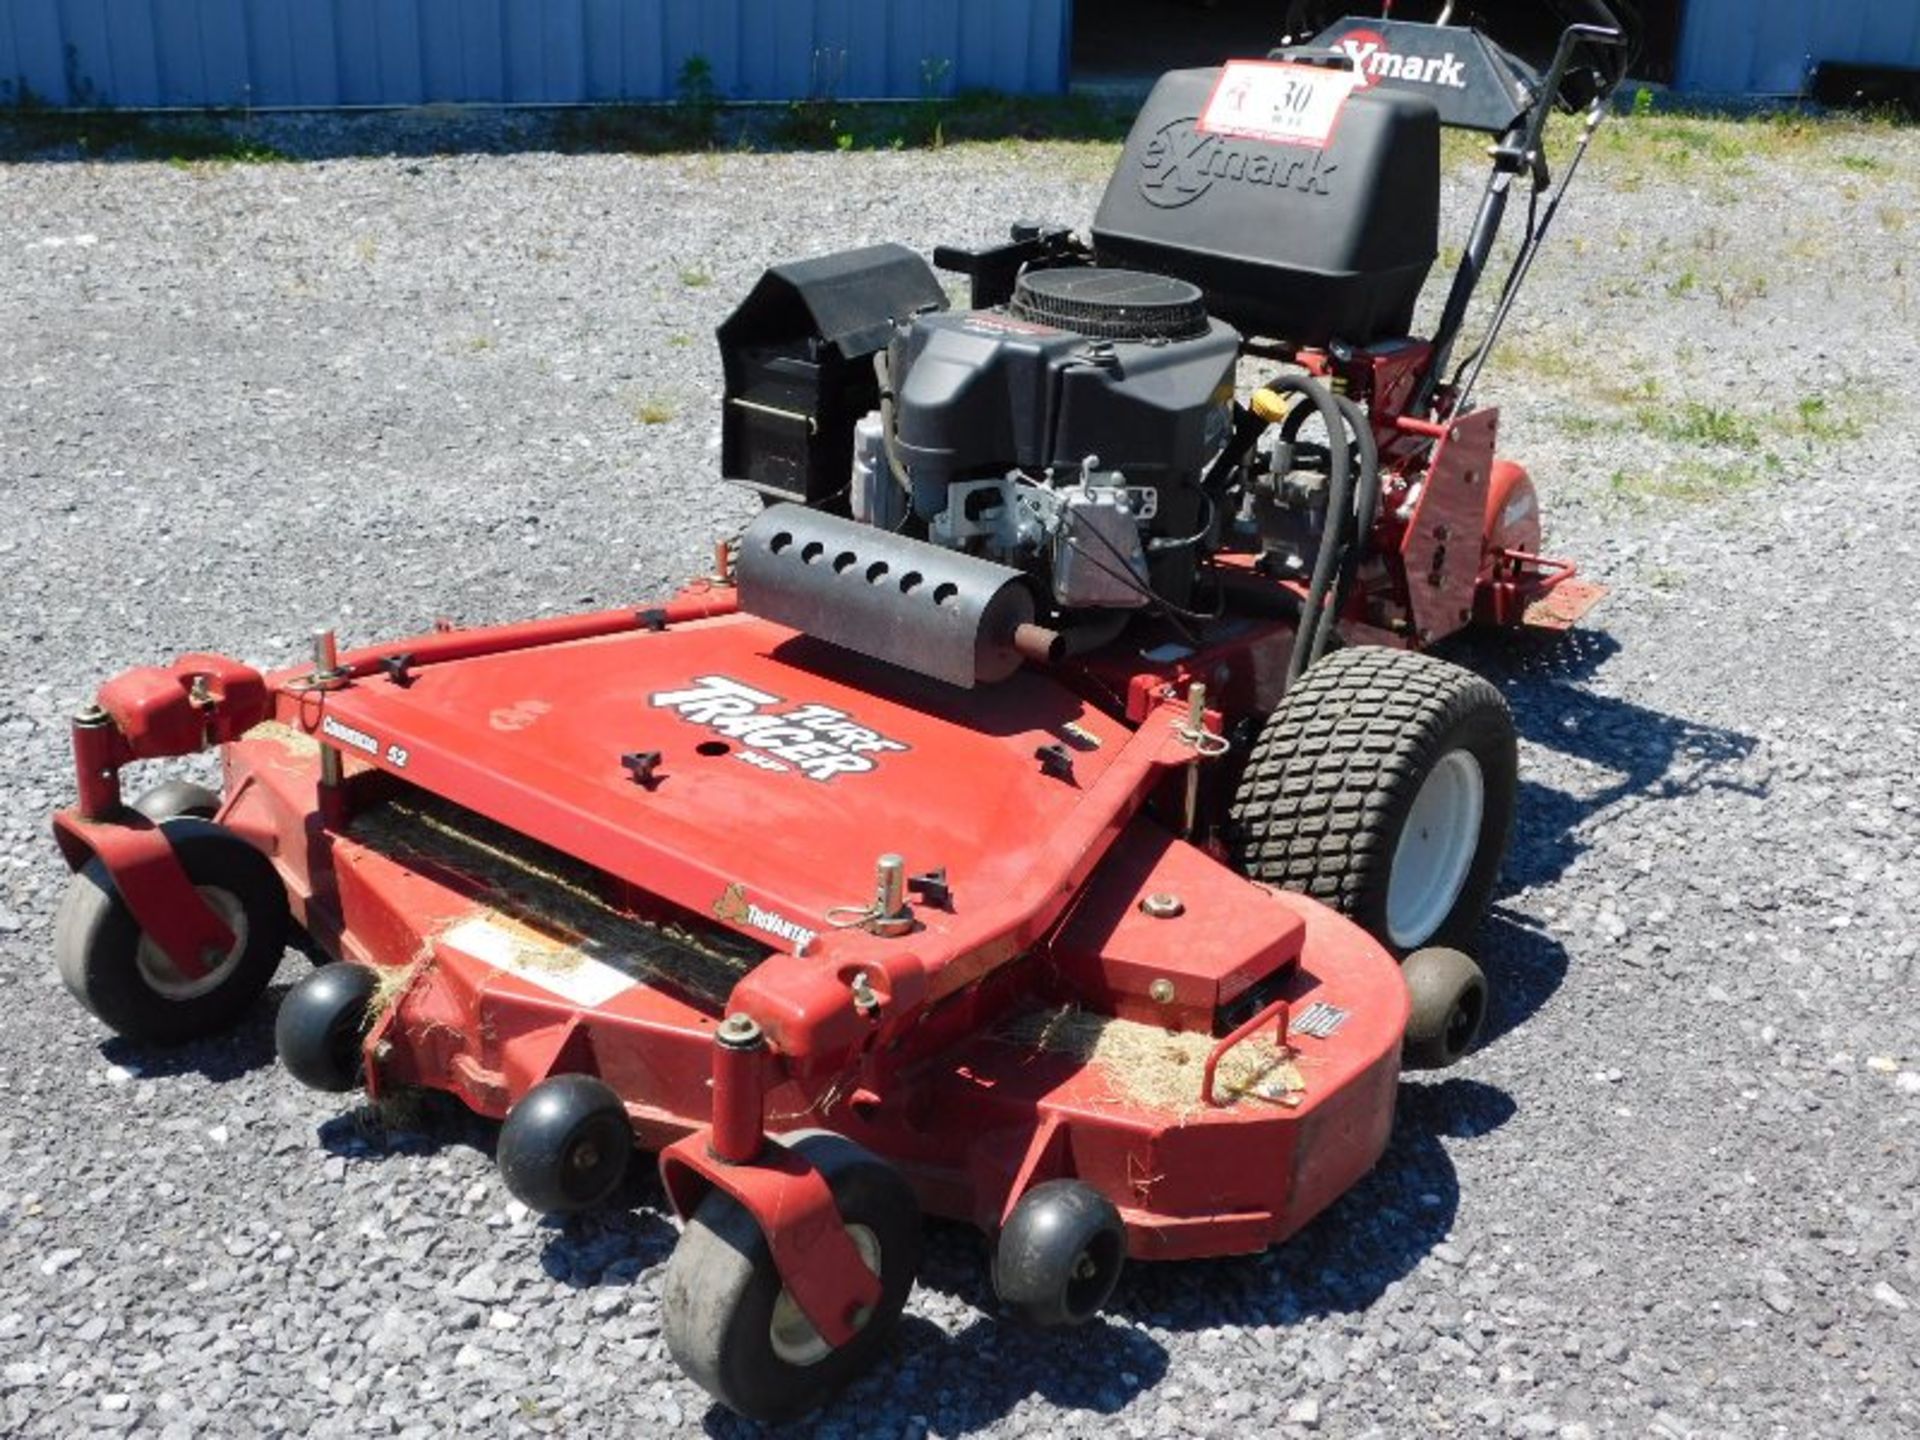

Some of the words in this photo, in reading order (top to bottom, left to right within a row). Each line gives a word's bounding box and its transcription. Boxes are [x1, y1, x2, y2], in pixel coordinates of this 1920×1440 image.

[651, 675, 876, 780] TRACER
[780, 703, 910, 752] TURF
[386, 744, 408, 767] 52
